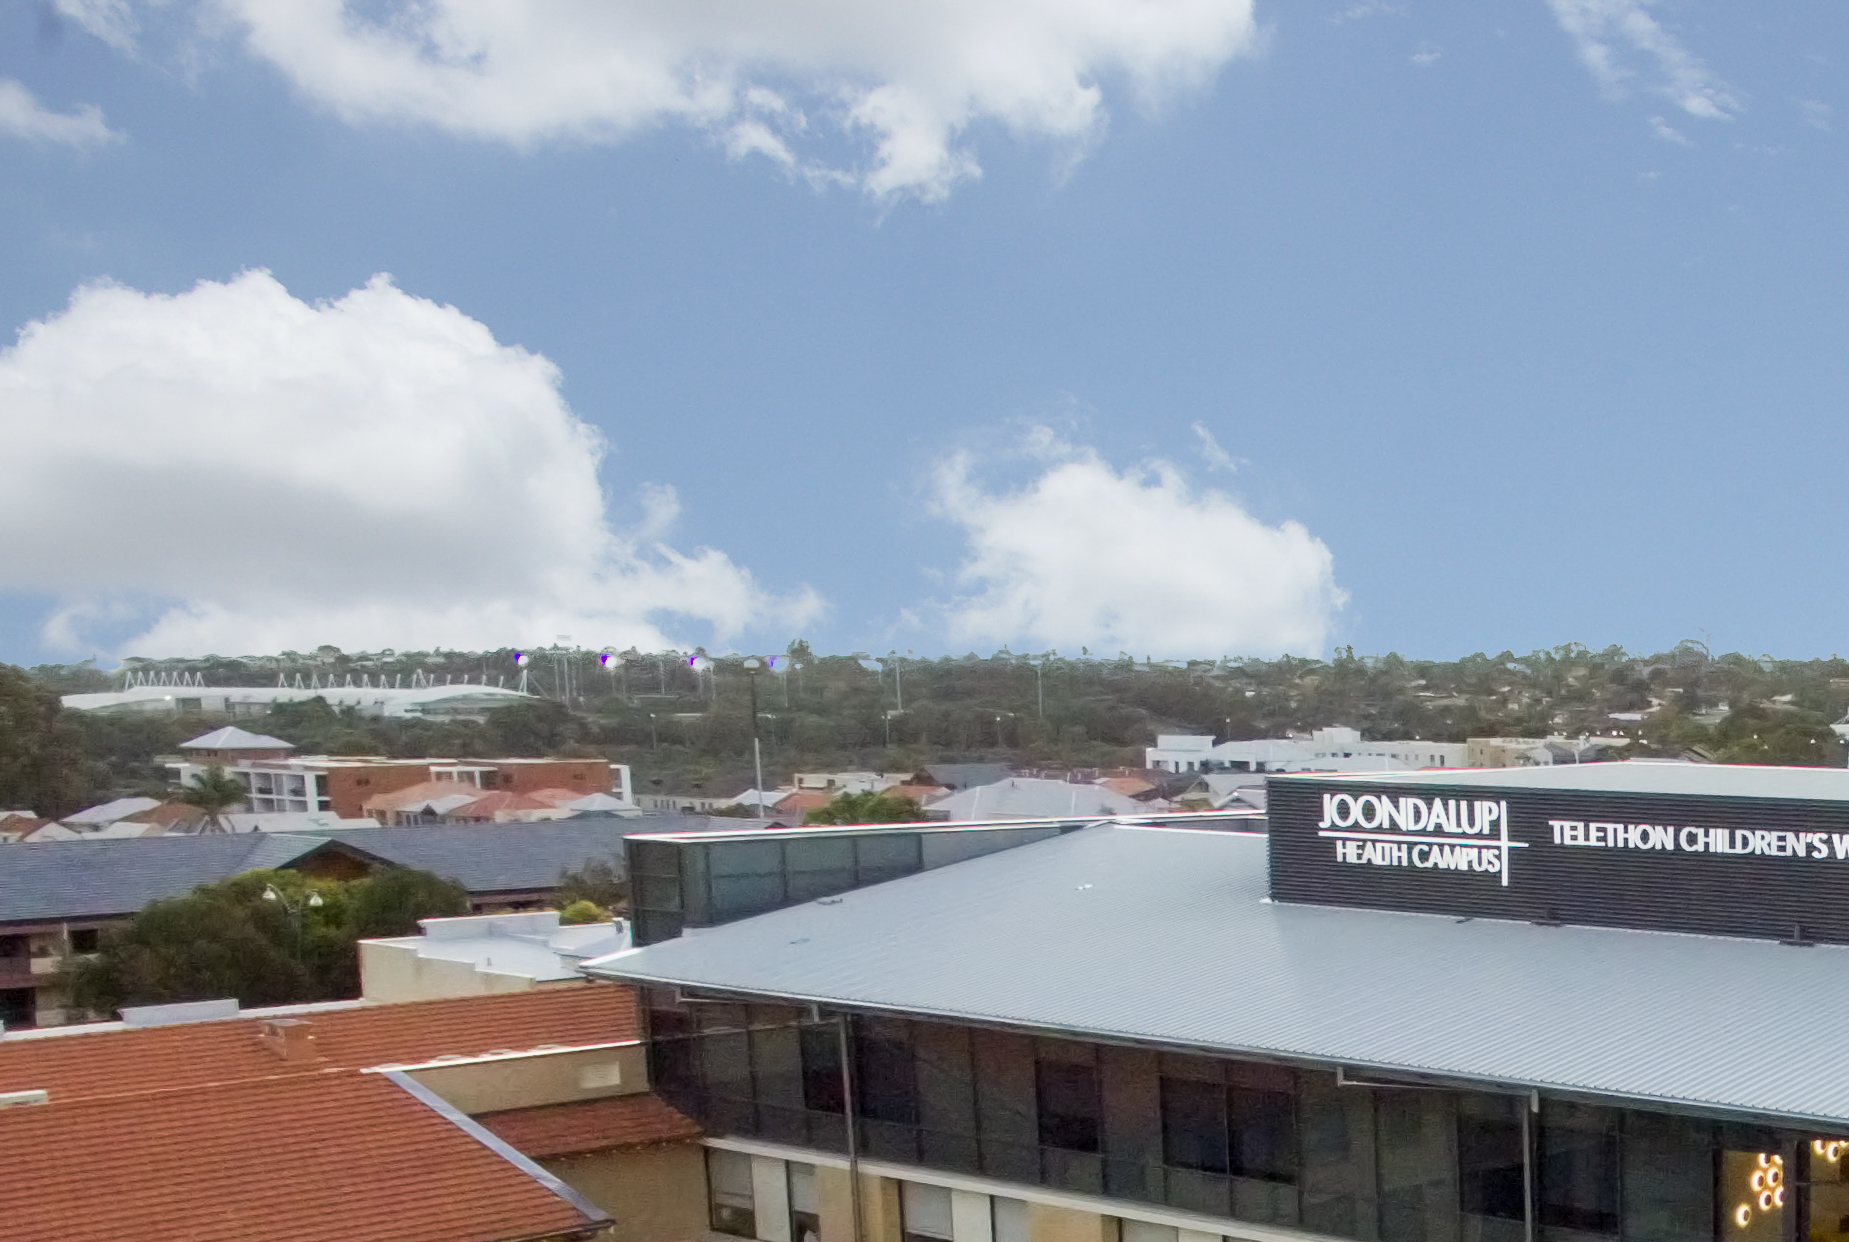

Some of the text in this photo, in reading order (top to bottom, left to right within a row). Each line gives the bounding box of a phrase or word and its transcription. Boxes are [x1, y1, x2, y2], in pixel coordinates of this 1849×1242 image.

[1318, 793, 1500, 835] JOONDALUP
[1335, 839, 1501, 873] HEALTH CAMPUS
[1548, 820, 1675, 851] TELETHON
[1679, 826, 1829, 860] CHILDREN'S
